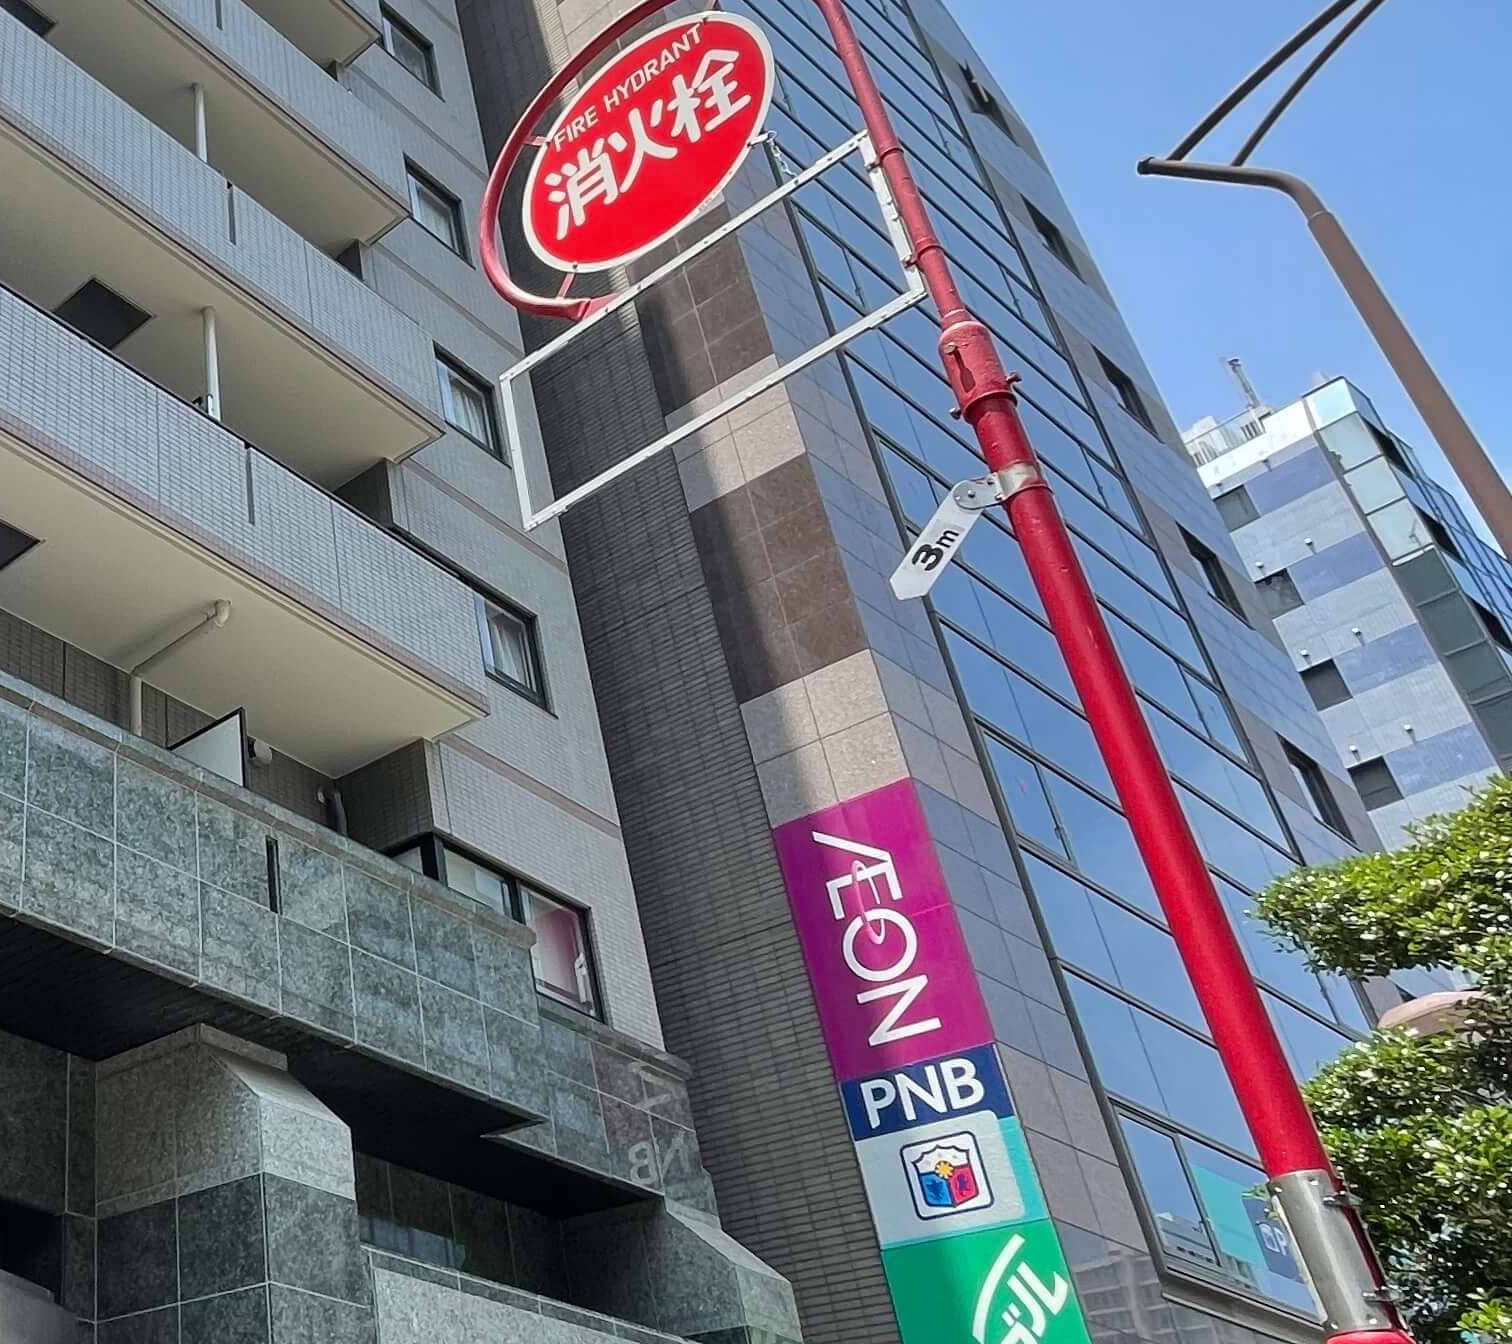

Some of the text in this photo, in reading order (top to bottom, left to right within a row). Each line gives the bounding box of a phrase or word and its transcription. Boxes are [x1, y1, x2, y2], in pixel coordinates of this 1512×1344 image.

[552, 23, 703, 152] FIRE HYDRANT
[544, 48, 752, 241] 消火栓
[912, 529, 960, 571] 3m
[859, 1058, 985, 1130] PNB
